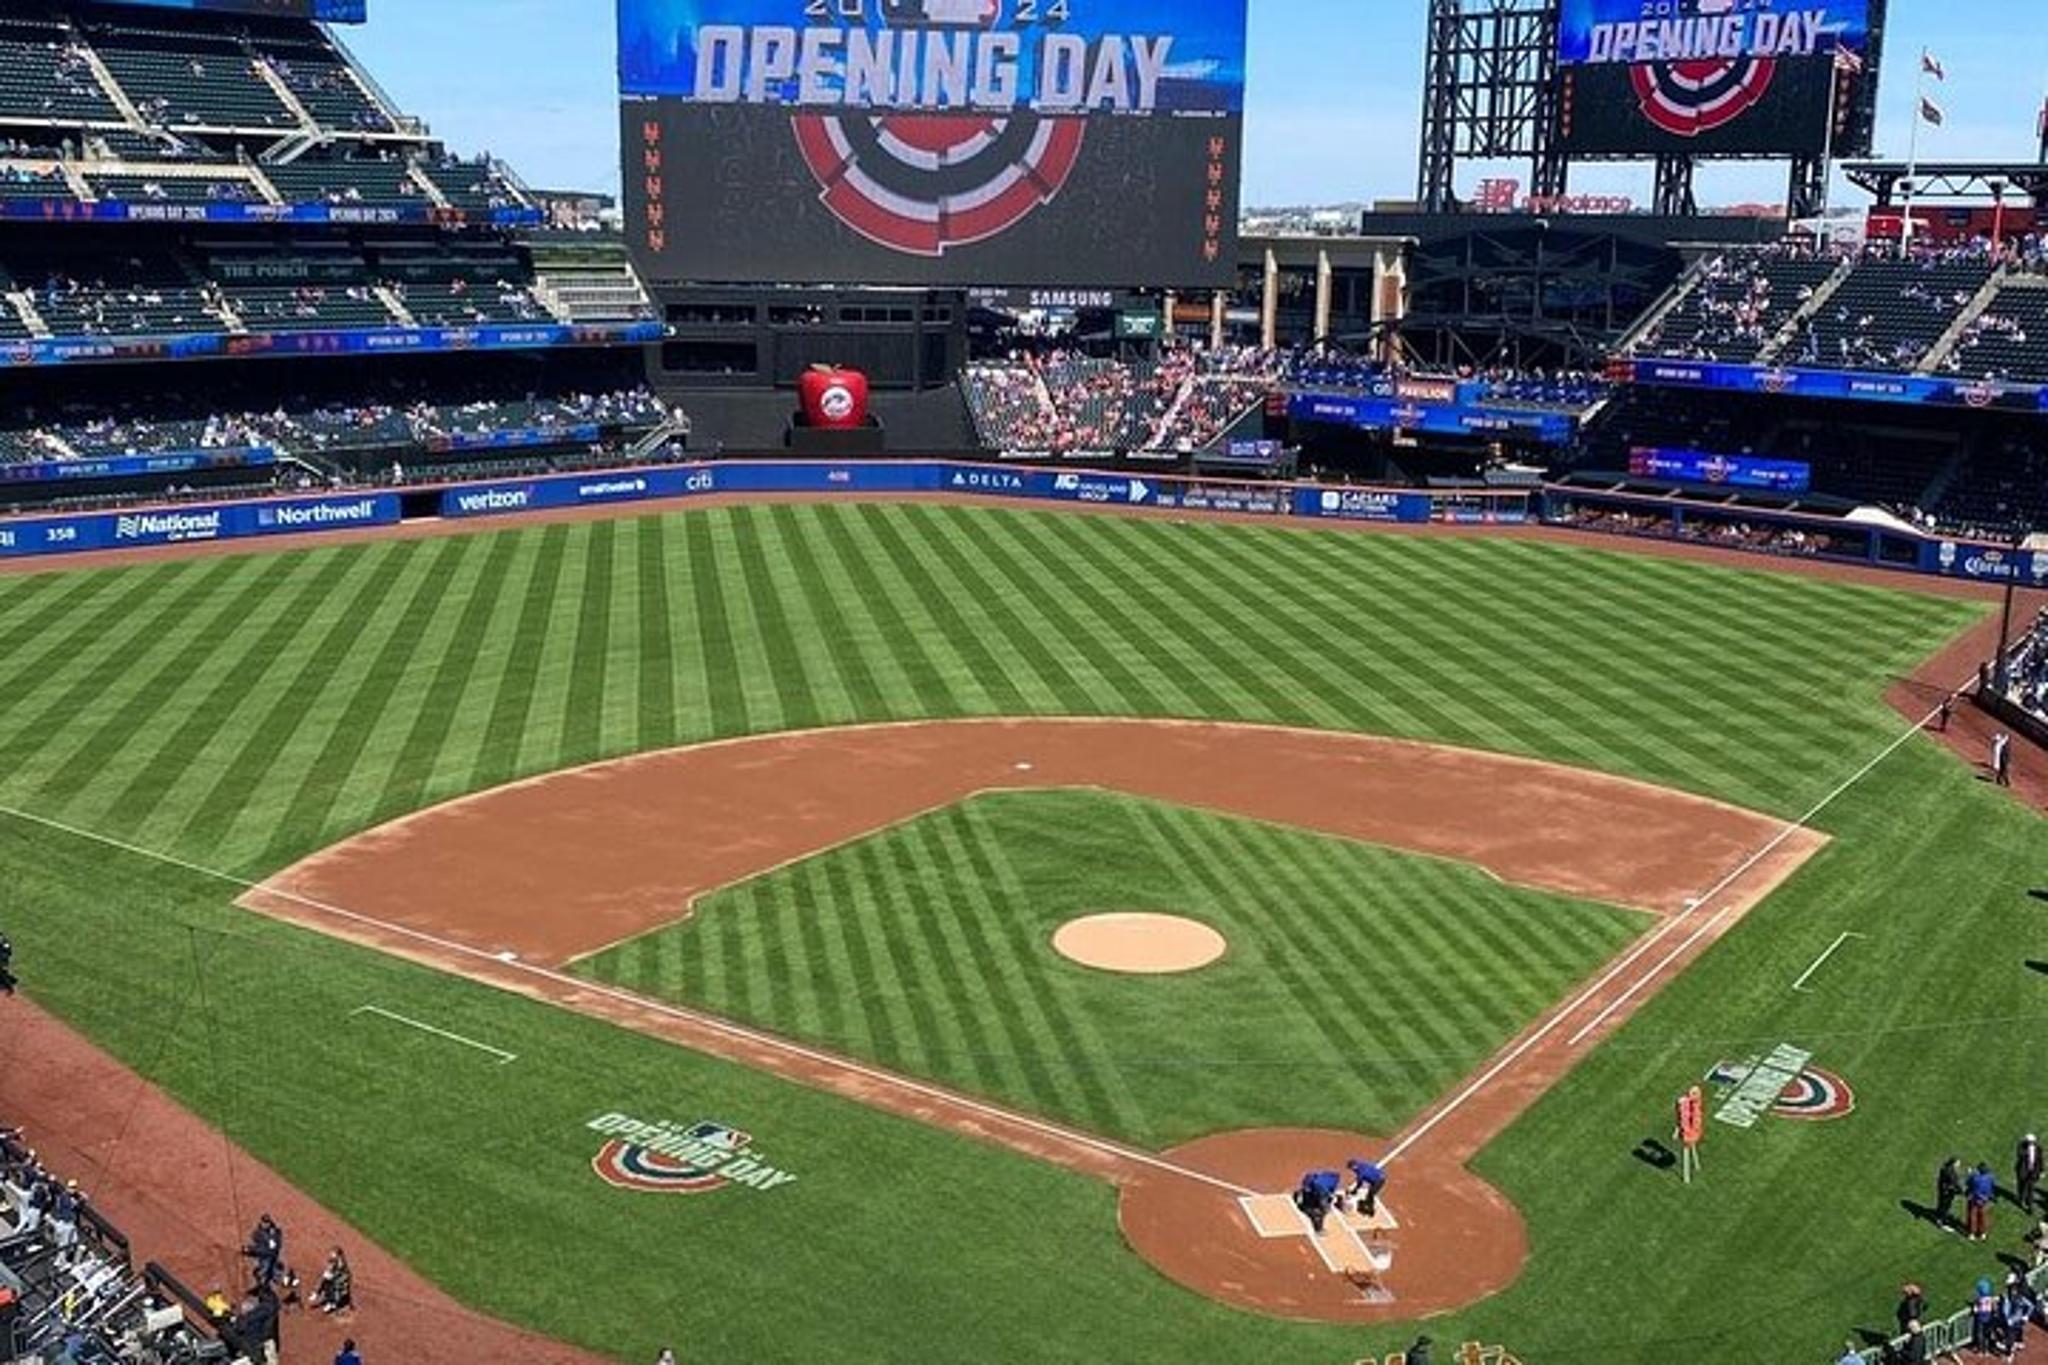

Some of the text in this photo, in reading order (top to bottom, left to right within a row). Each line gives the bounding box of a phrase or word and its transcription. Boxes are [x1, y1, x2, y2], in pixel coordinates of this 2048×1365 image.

[1589, 9, 1826, 63] OPENING DAY
[693, 25, 1173, 109] OPENING DAY
[1030, 291, 1113, 306] SAMSUNG
[686, 472, 712, 489] citi
[969, 473, 1022, 487] DELTA
[459, 489, 526, 511] verizon
[140, 511, 218, 532] National
[276, 502, 372, 525] Northwell
[47, 527, 76, 541] 358
[586, 1112, 797, 1191] OPENING DAY
